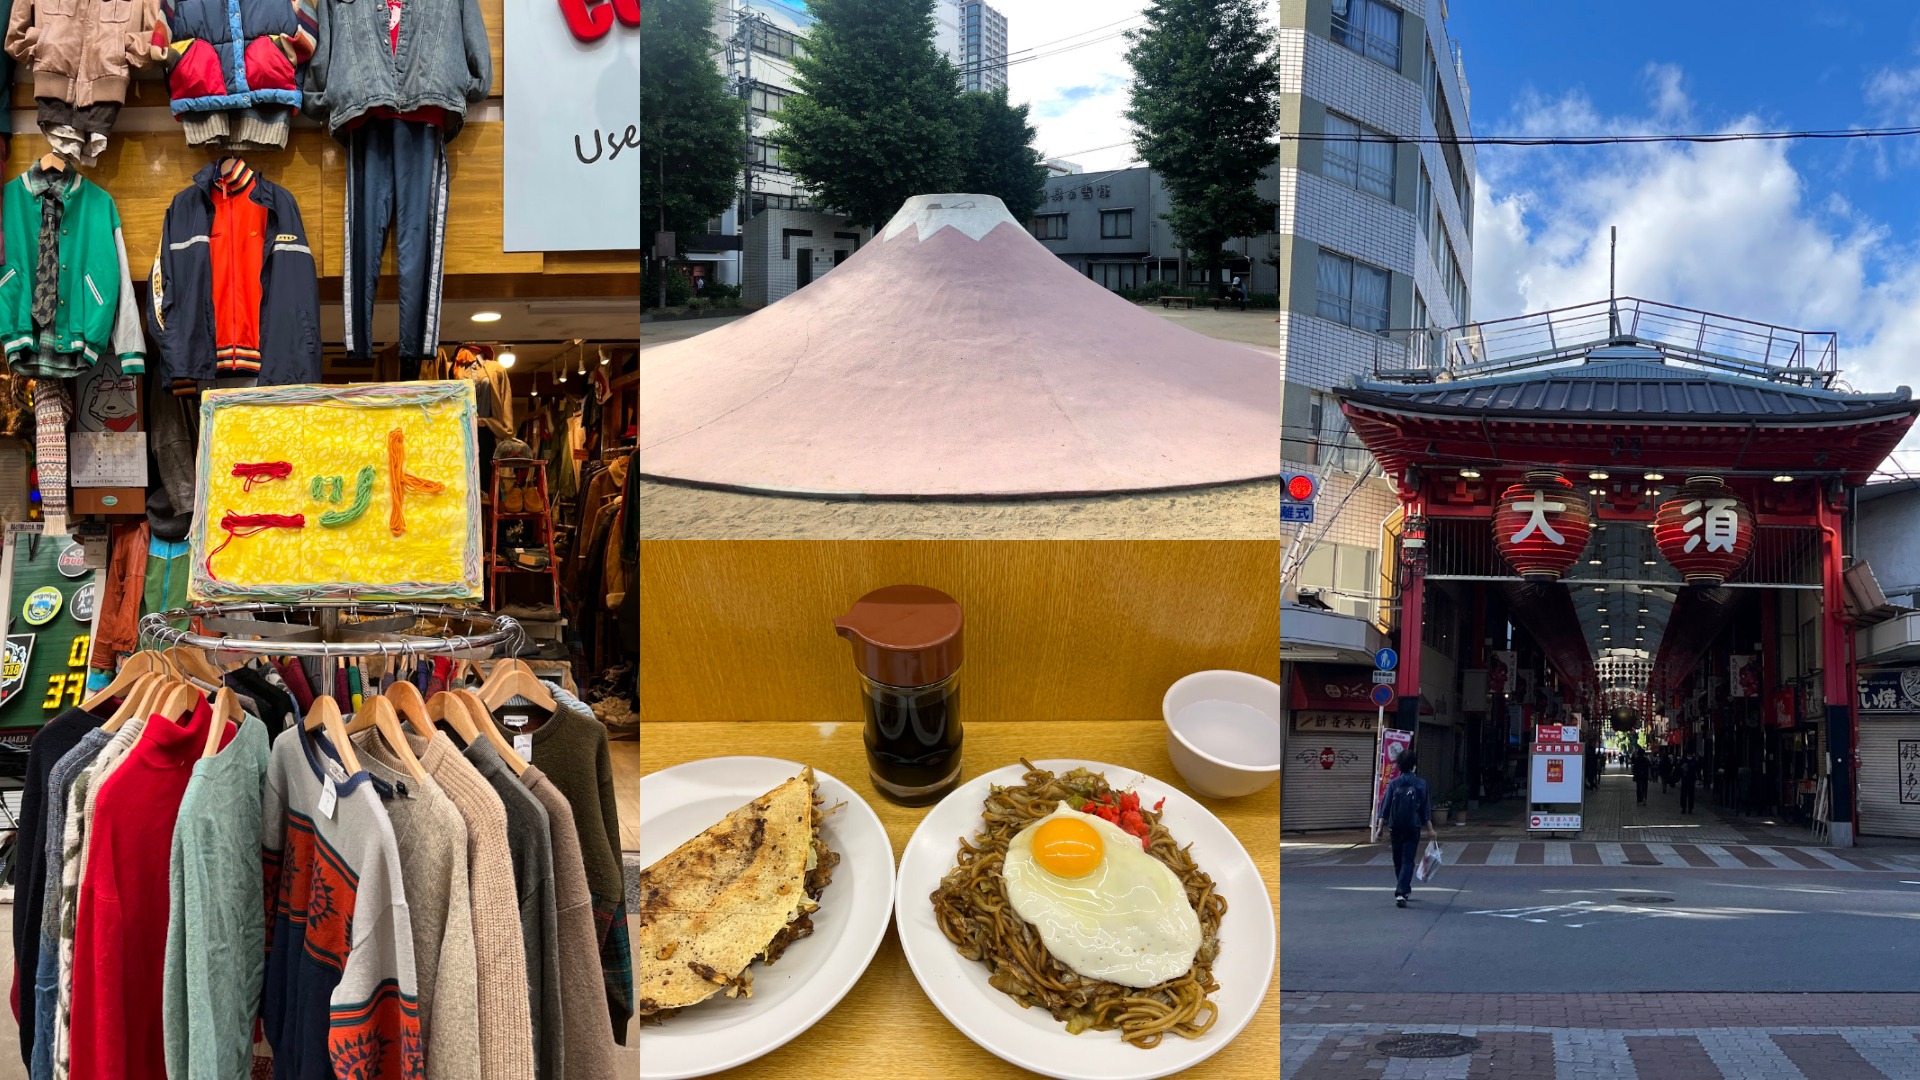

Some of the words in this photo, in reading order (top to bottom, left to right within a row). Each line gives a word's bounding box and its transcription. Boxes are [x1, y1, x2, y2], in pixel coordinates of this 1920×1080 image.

[220, 427, 446, 537] ニット
[1510, 491, 1566, 546] 大
[1682, 498, 1739, 554] 須
[1315, 714, 1372, 731] 新雀本店
